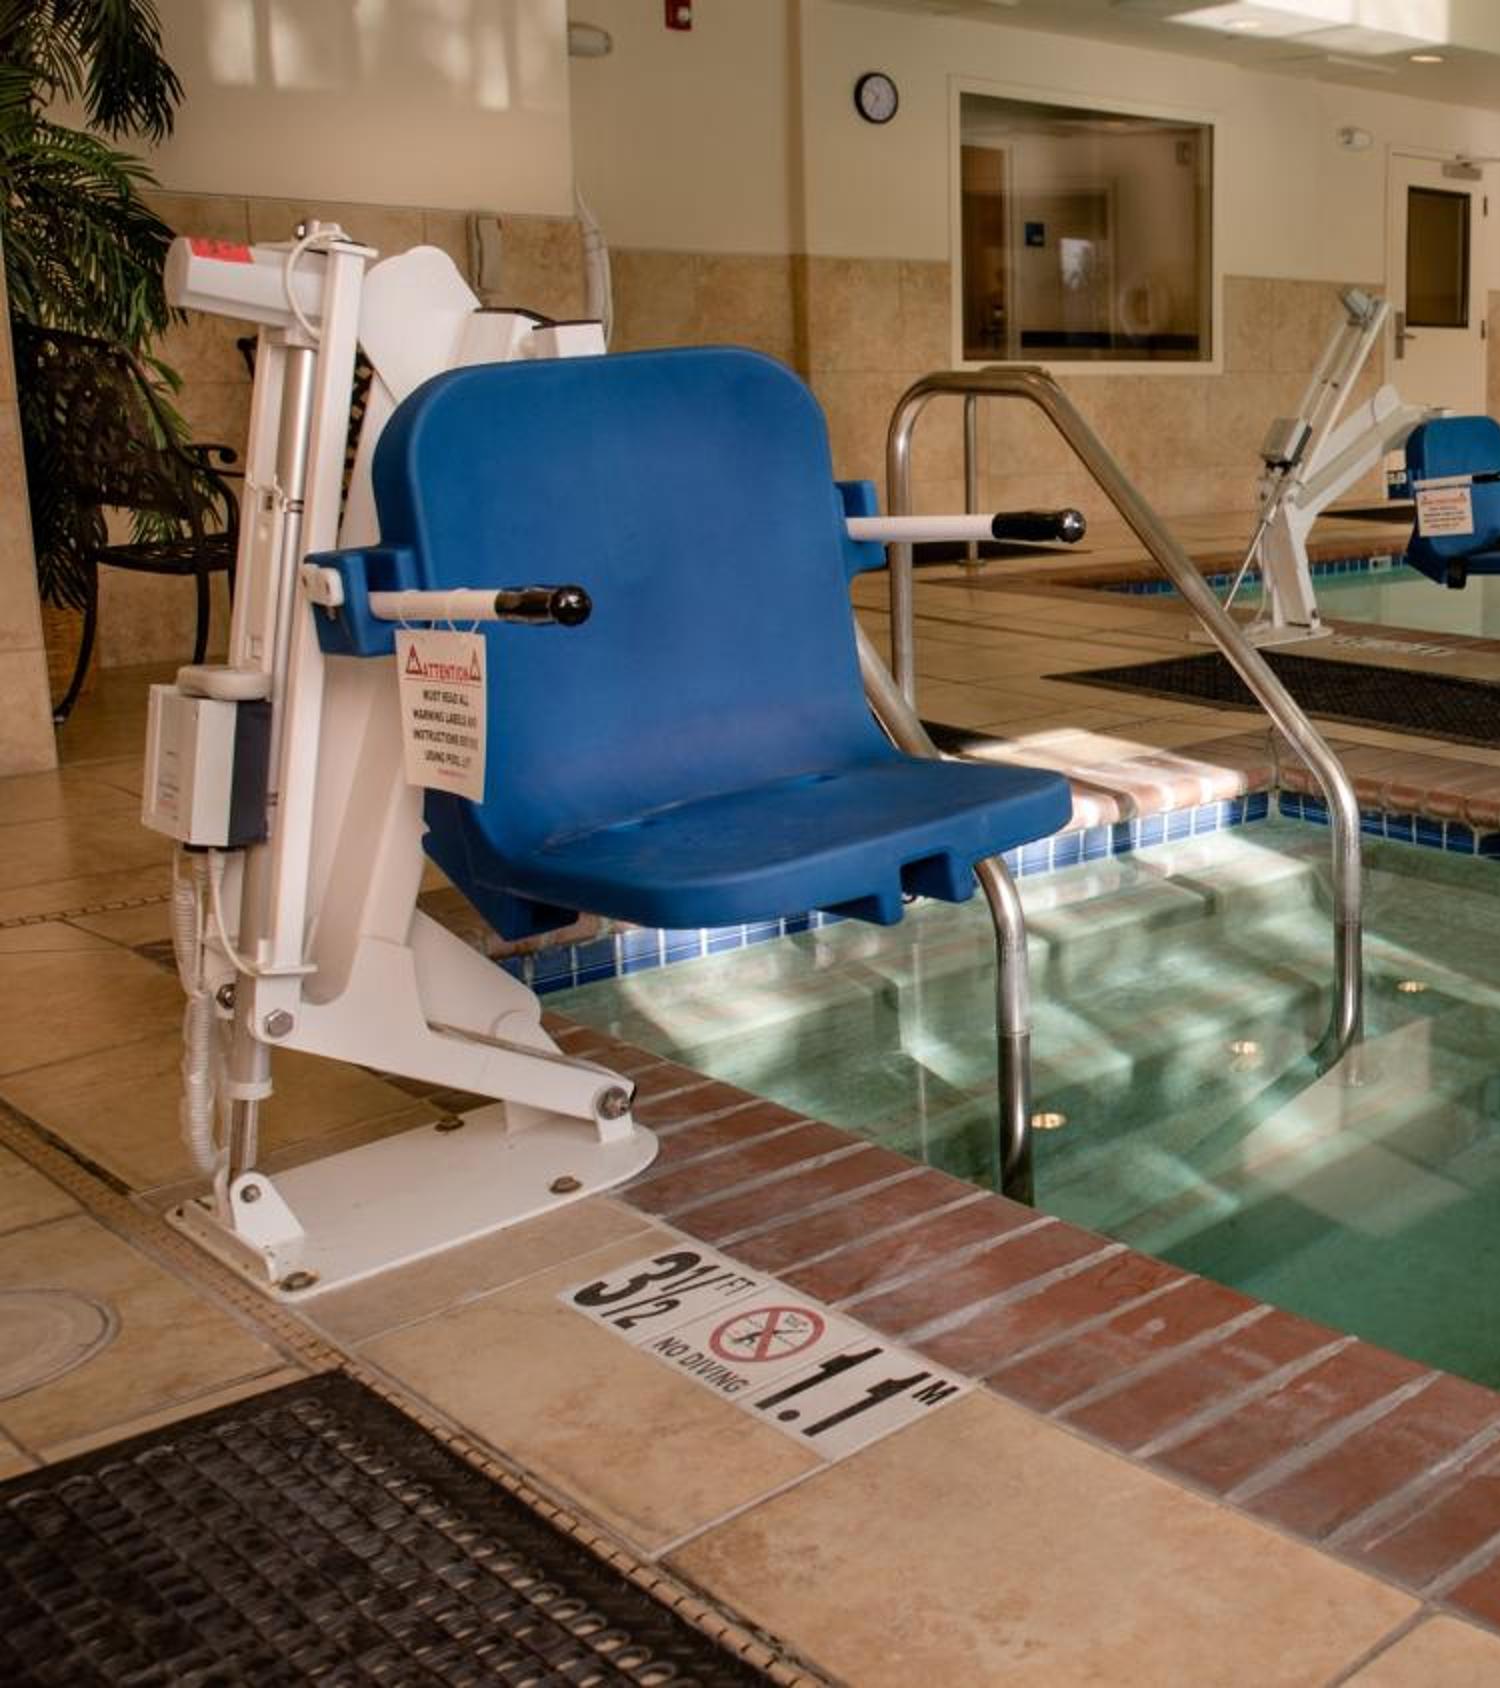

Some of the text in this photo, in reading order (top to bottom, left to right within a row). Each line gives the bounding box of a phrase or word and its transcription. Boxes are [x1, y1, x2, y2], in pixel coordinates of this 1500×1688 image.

[422, 662, 471, 682] ATTENTION
[714, 1276, 757, 1298] FT
[653, 1336, 750, 1394] NO DIVING
[754, 1346, 960, 1438] 1.1 M
